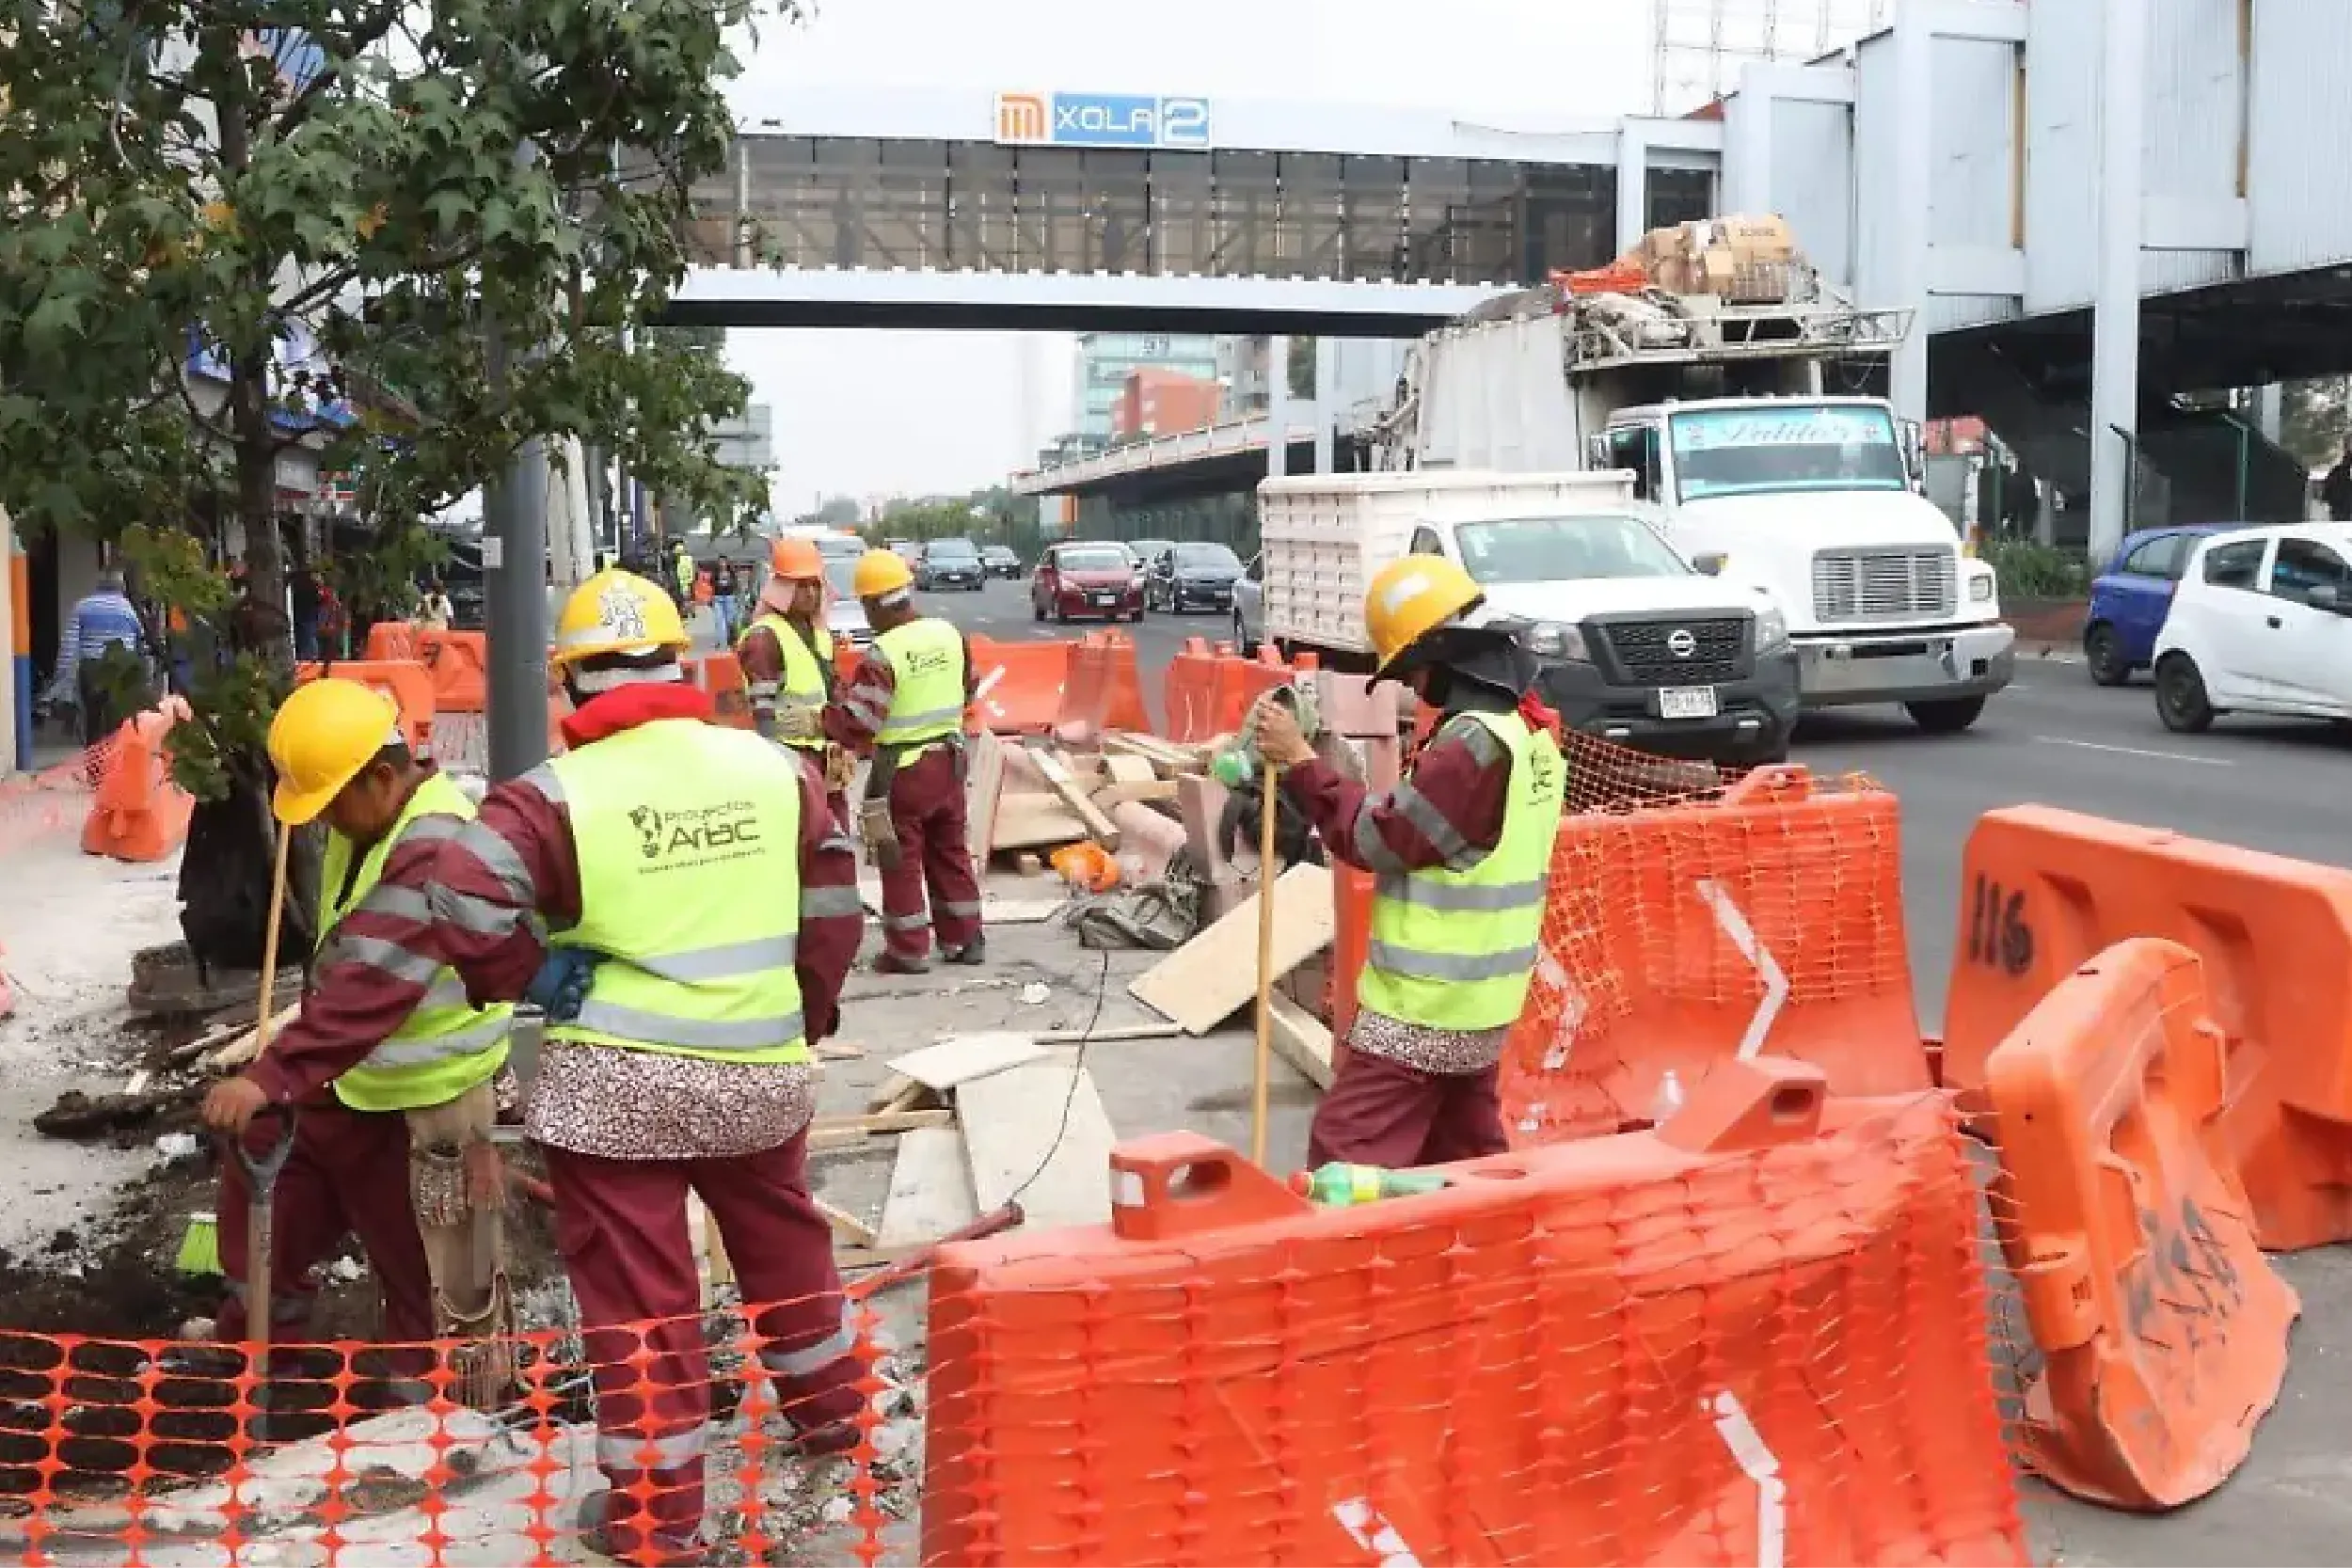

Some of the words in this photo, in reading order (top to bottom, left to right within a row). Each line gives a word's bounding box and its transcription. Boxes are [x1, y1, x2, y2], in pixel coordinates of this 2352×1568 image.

[1056, 104, 1153, 133] XOLA
[1164, 99, 1208, 142] 2
[1968, 870, 2034, 979] 116
